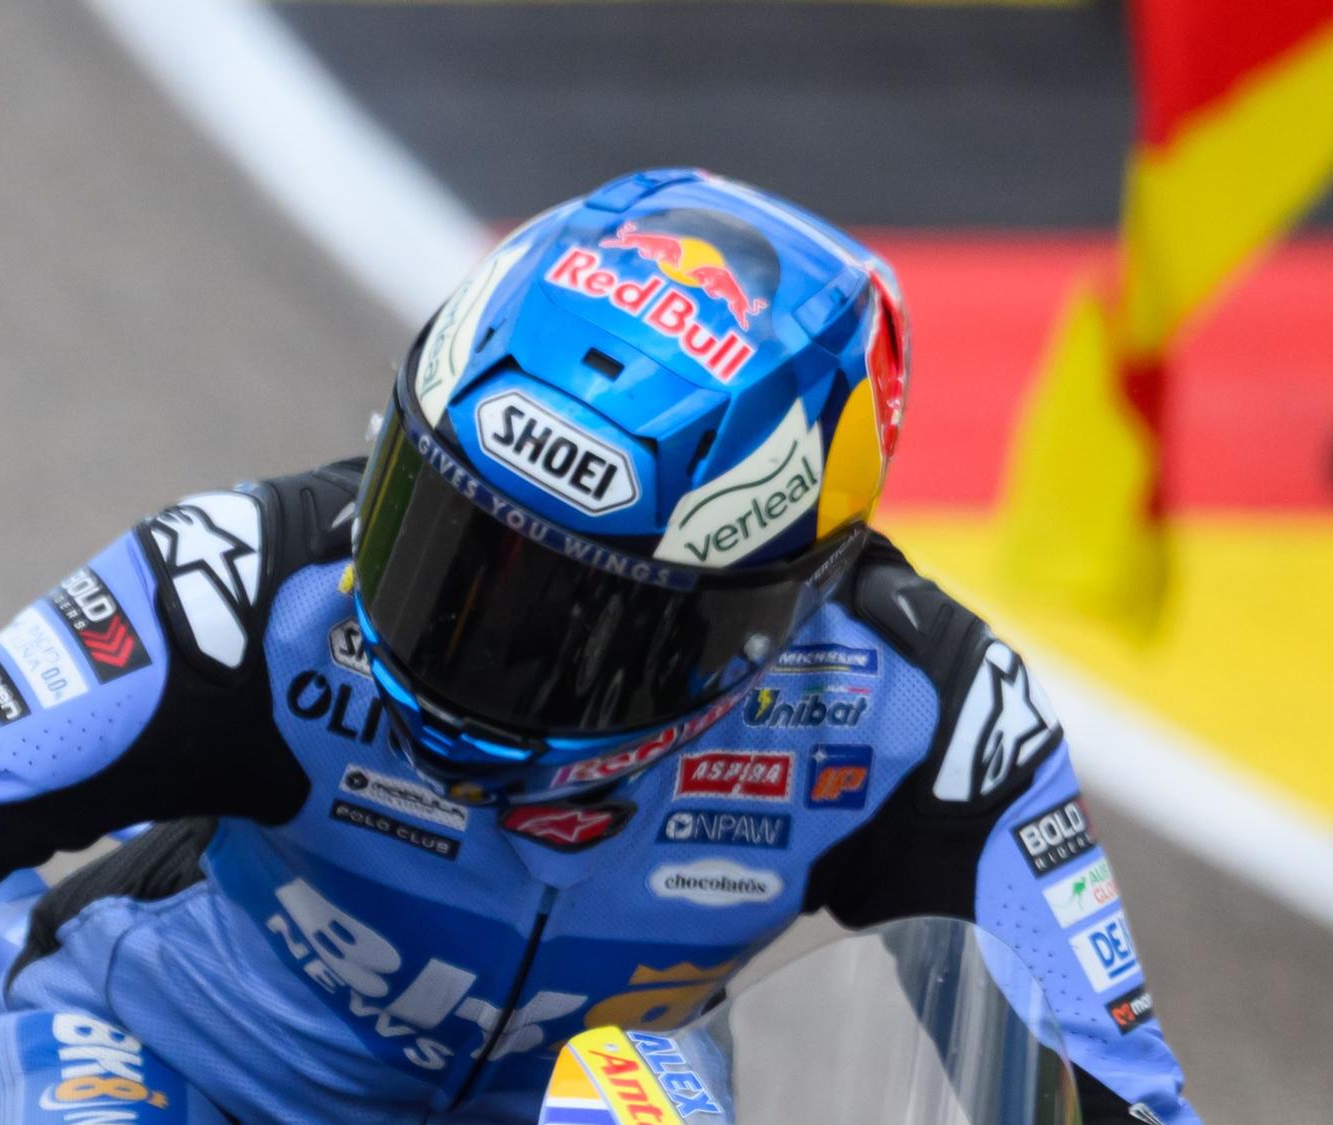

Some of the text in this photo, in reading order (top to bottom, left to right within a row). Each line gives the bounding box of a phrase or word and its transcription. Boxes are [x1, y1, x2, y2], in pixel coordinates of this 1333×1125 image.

[545, 249, 756, 384] Red Bull
[491, 404, 619, 502] SHOEI
[418, 434, 671, 586] GIVES YOU WINGS
[682, 457, 820, 564] verleal
[741, 688, 869, 728] Unibat
[691, 759, 781, 785] ASPIRA
[335, 804, 390, 832] POLO
[1019, 800, 1086, 857] BOLD
[266, 912, 454, 1071] NEWS
[52, 1013, 149, 1102] BK8
[630, 1030, 723, 1118] ALEX
